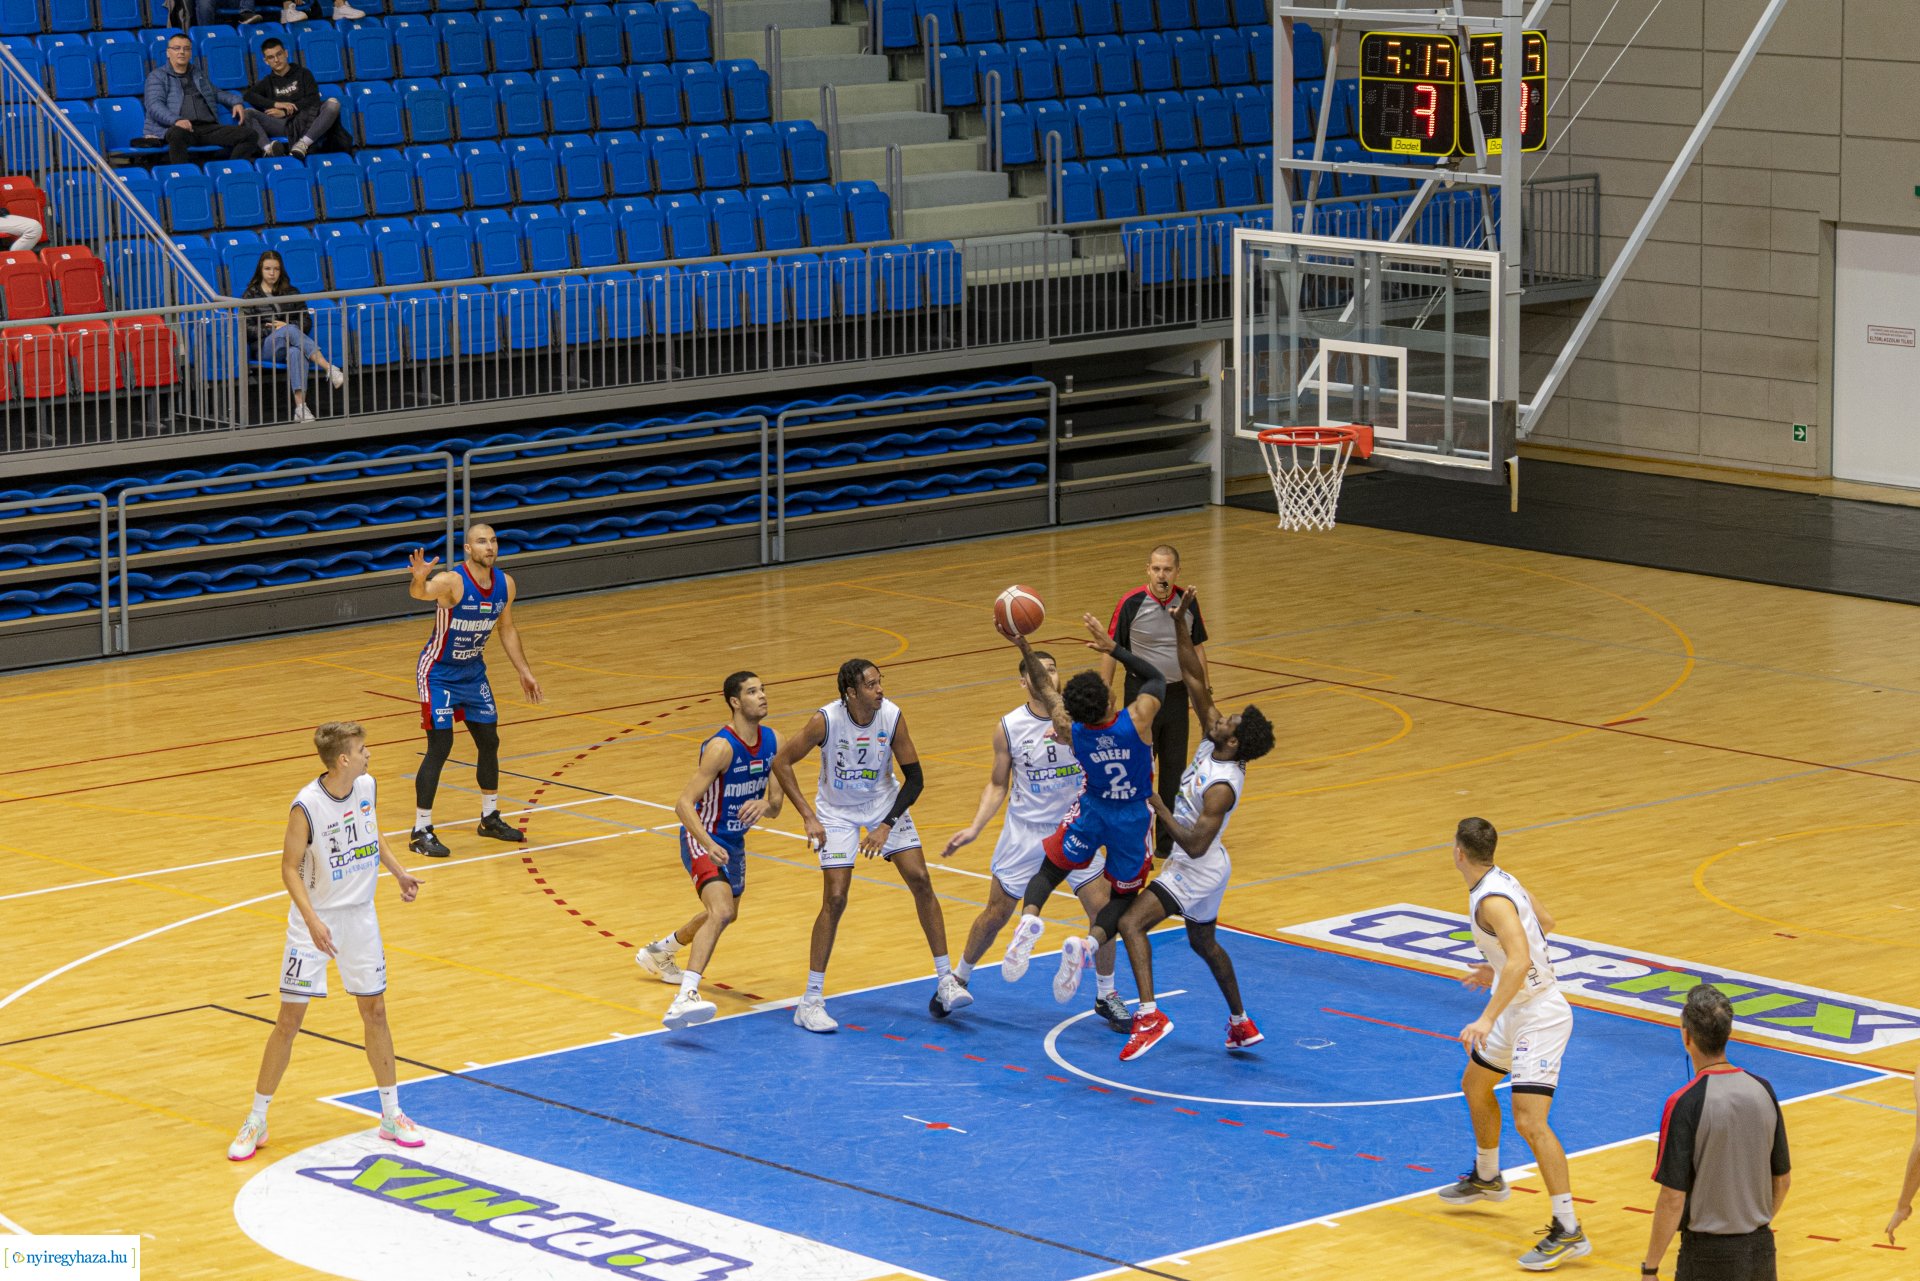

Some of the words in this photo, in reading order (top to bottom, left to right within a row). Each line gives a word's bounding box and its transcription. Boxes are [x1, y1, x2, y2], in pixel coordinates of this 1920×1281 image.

[1387, 41, 1450, 77] 5:15
[1414, 84, 1437, 139] 3
[1394, 139, 1420, 151] Bodet
[474, 633, 483, 648] 7
[443, 689, 450, 707] 7
[857, 748, 868, 765] 2
[1047, 745, 1057, 763] 8
[1089, 748, 1131, 763] GREEN
[1104, 762, 1131, 792] 2
[327, 821, 339, 829] JAKO
[345, 822, 358, 845] 21
[286, 956, 302, 978] 21
